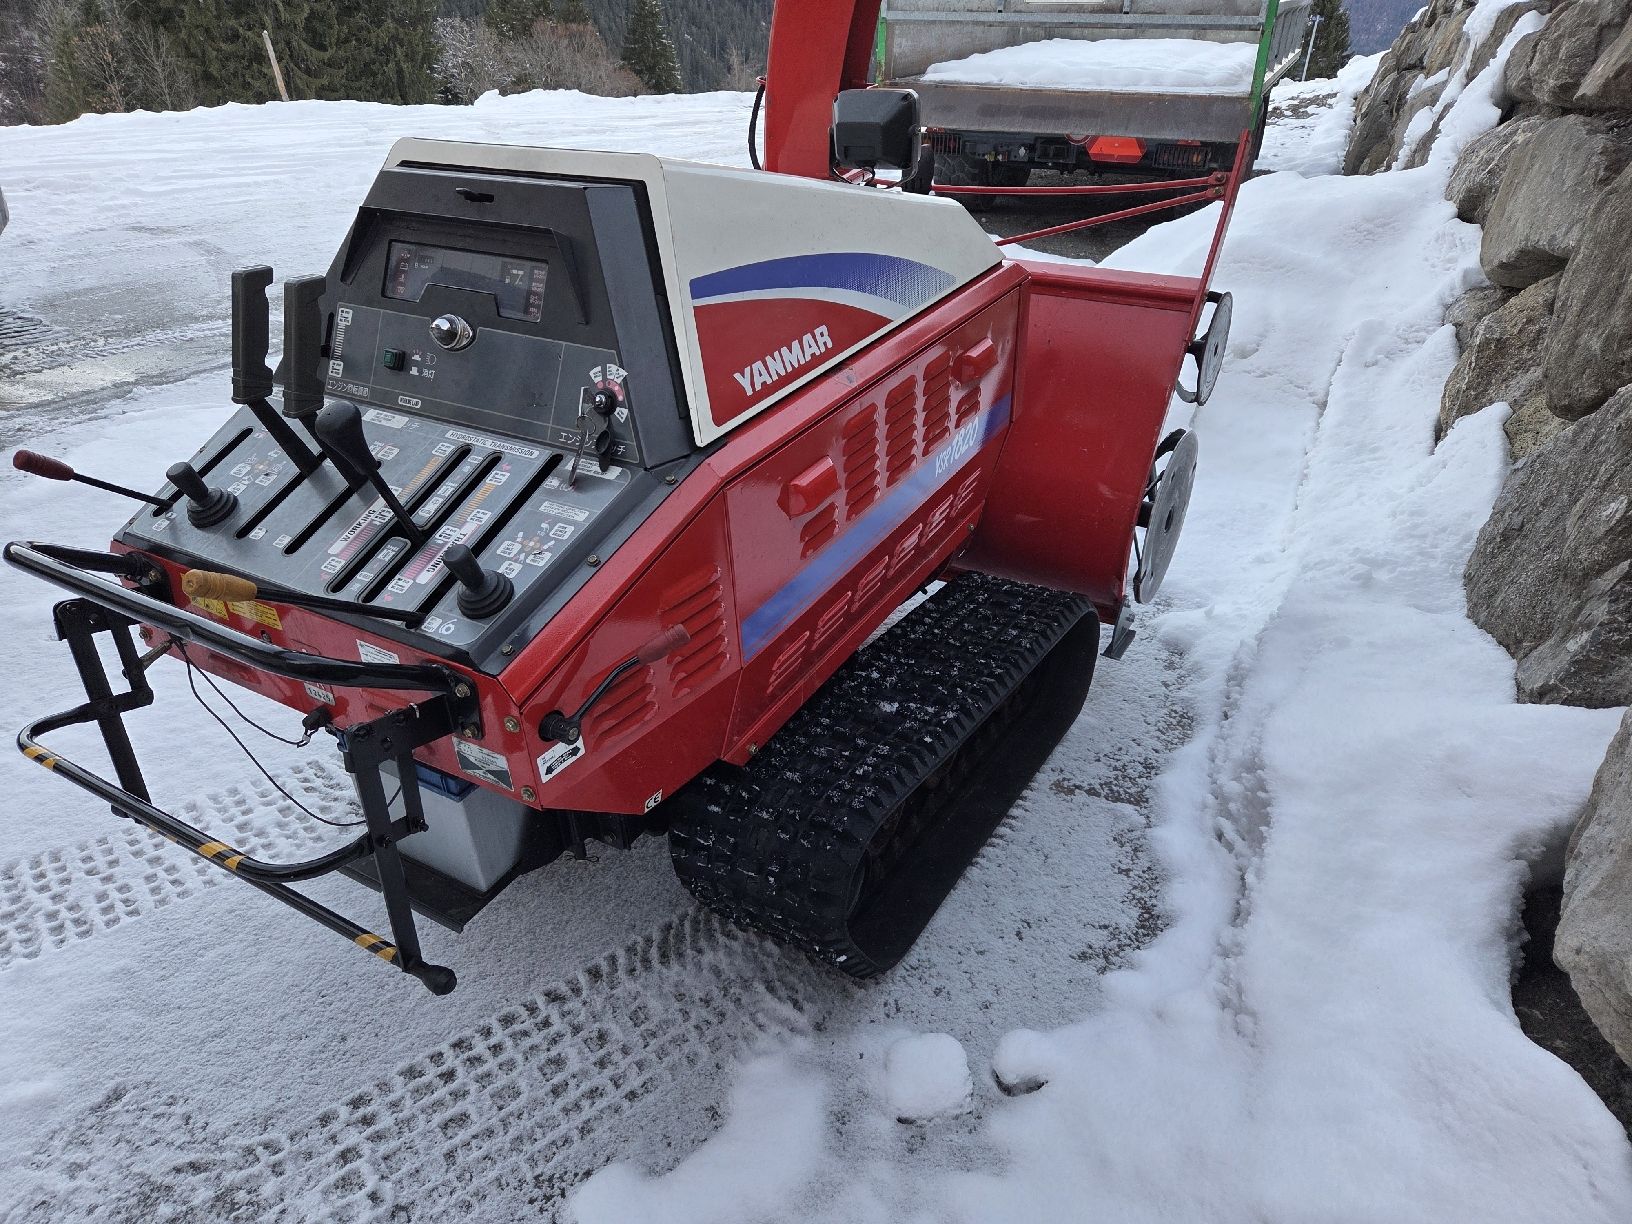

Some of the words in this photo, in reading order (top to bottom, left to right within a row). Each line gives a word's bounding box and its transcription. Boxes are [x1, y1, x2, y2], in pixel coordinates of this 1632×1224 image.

[733, 325, 832, 396] YANMAR
[449, 432, 487, 446] HYDROSTATIC
[489, 441, 536, 457] TRANSMISSION
[340, 509, 377, 542] WORKING
